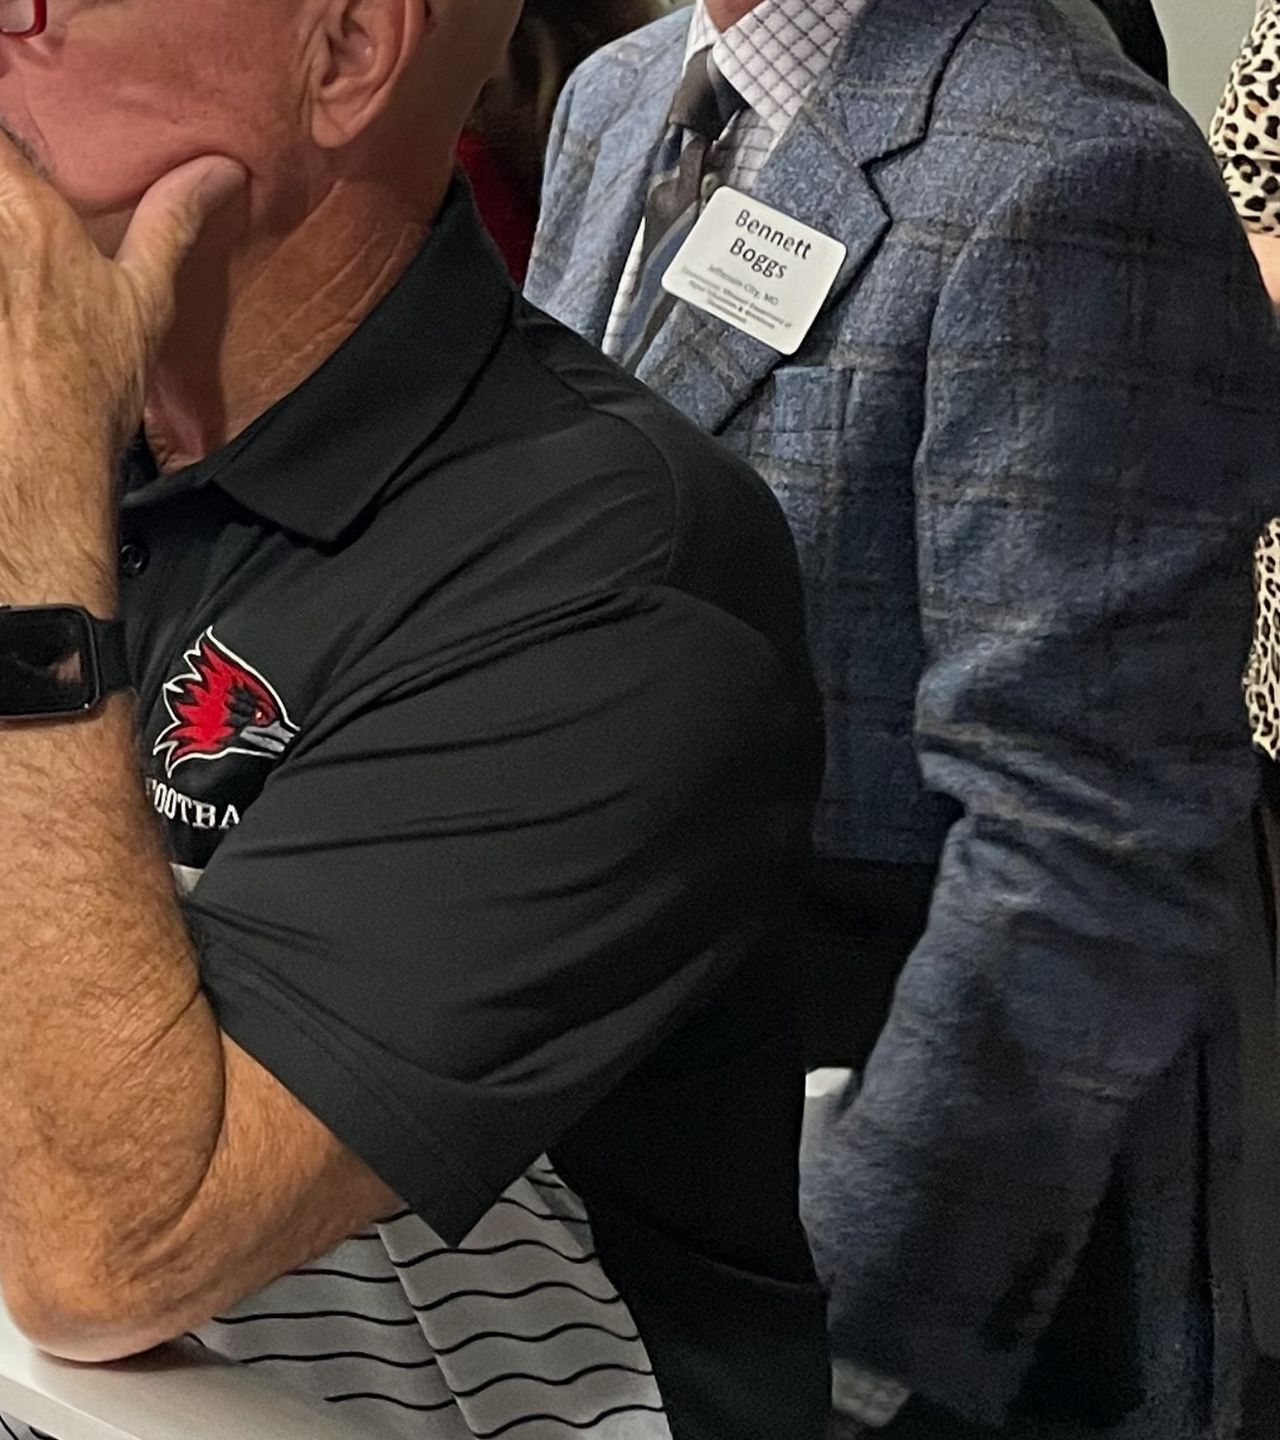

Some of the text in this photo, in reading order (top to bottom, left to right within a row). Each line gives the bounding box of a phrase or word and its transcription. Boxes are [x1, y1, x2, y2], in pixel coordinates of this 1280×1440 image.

[729, 237, 788, 280] Boggs
[734, 209, 813, 260] Bennett
[145, 776, 241, 829] FOOTBA
